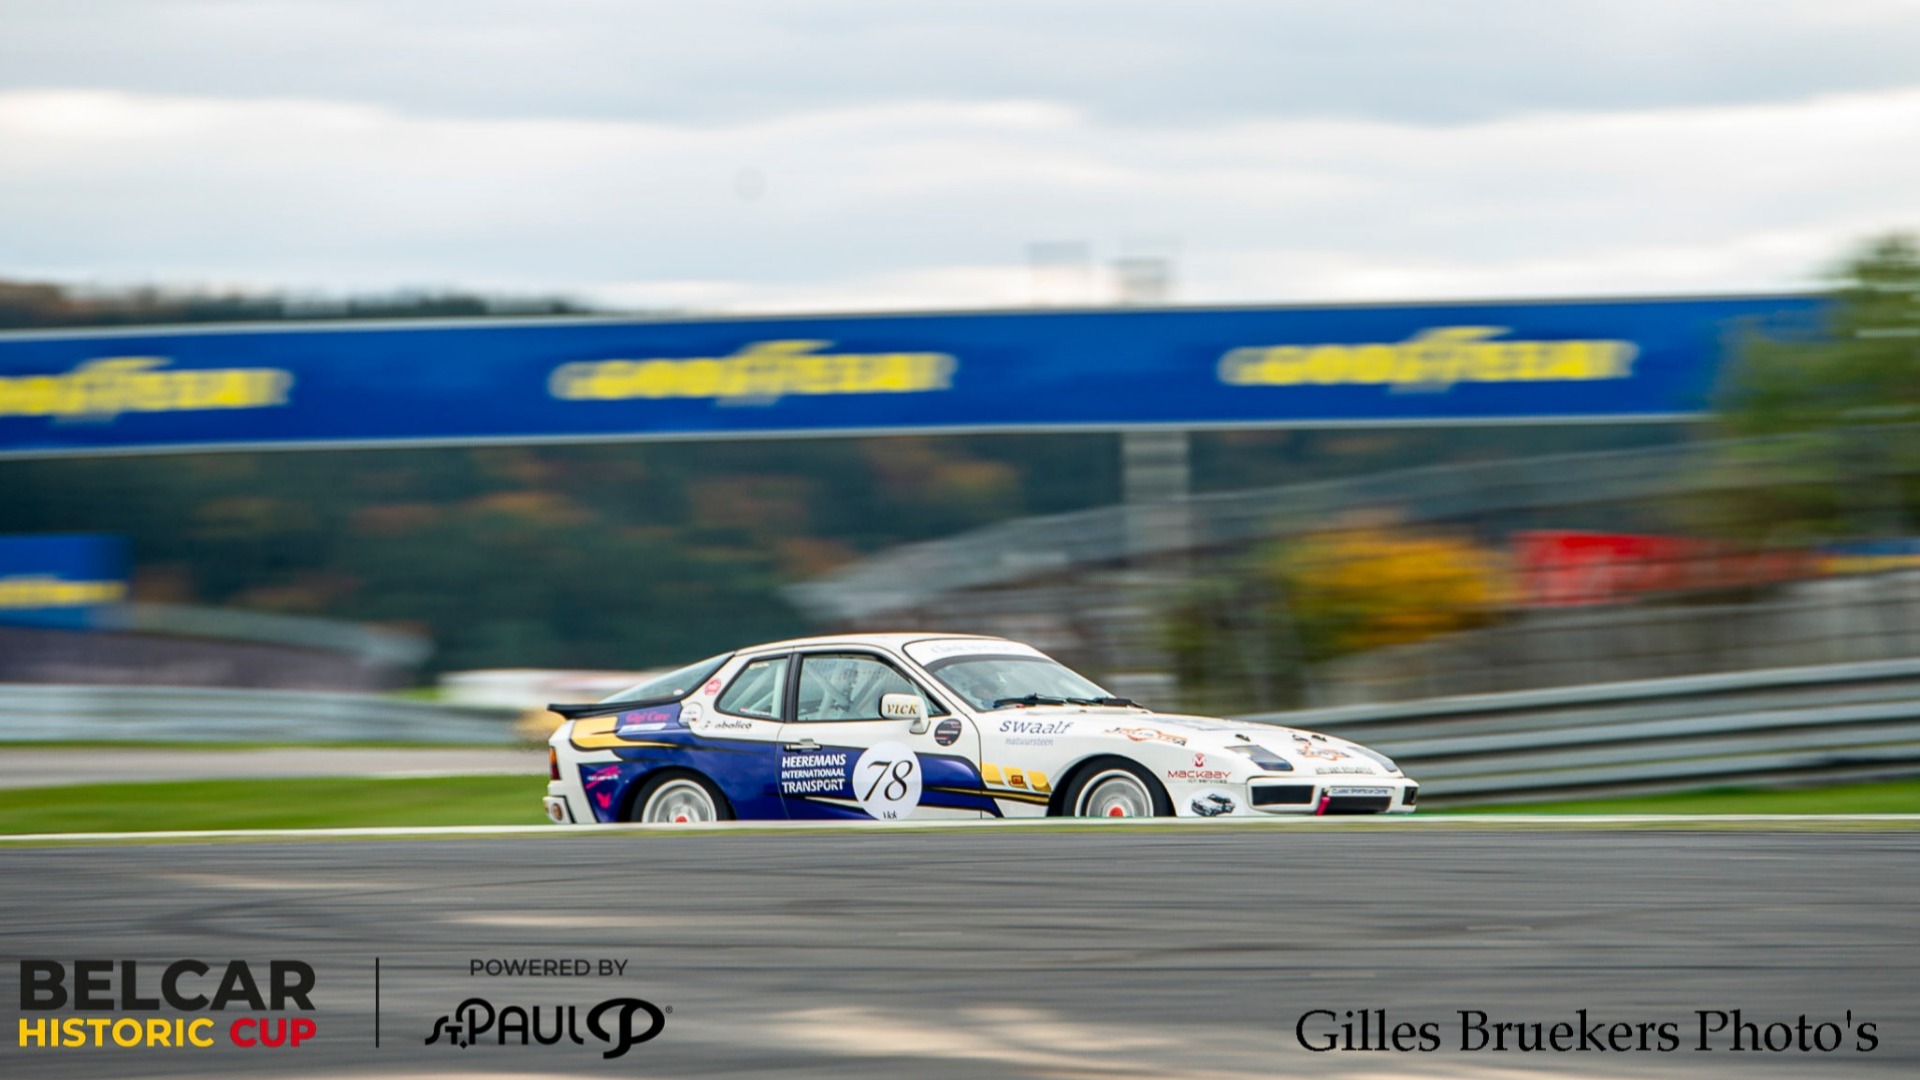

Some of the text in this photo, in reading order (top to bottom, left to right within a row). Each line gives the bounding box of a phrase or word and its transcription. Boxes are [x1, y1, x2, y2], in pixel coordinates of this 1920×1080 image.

[999, 719, 1074, 735] swaalf
[782, 754, 847, 769] HEEREMANS
[782, 767, 846, 780] INTERNATIONAAL
[863, 760, 913, 802] 78
[782, 780, 846, 794] TRANSPORT
